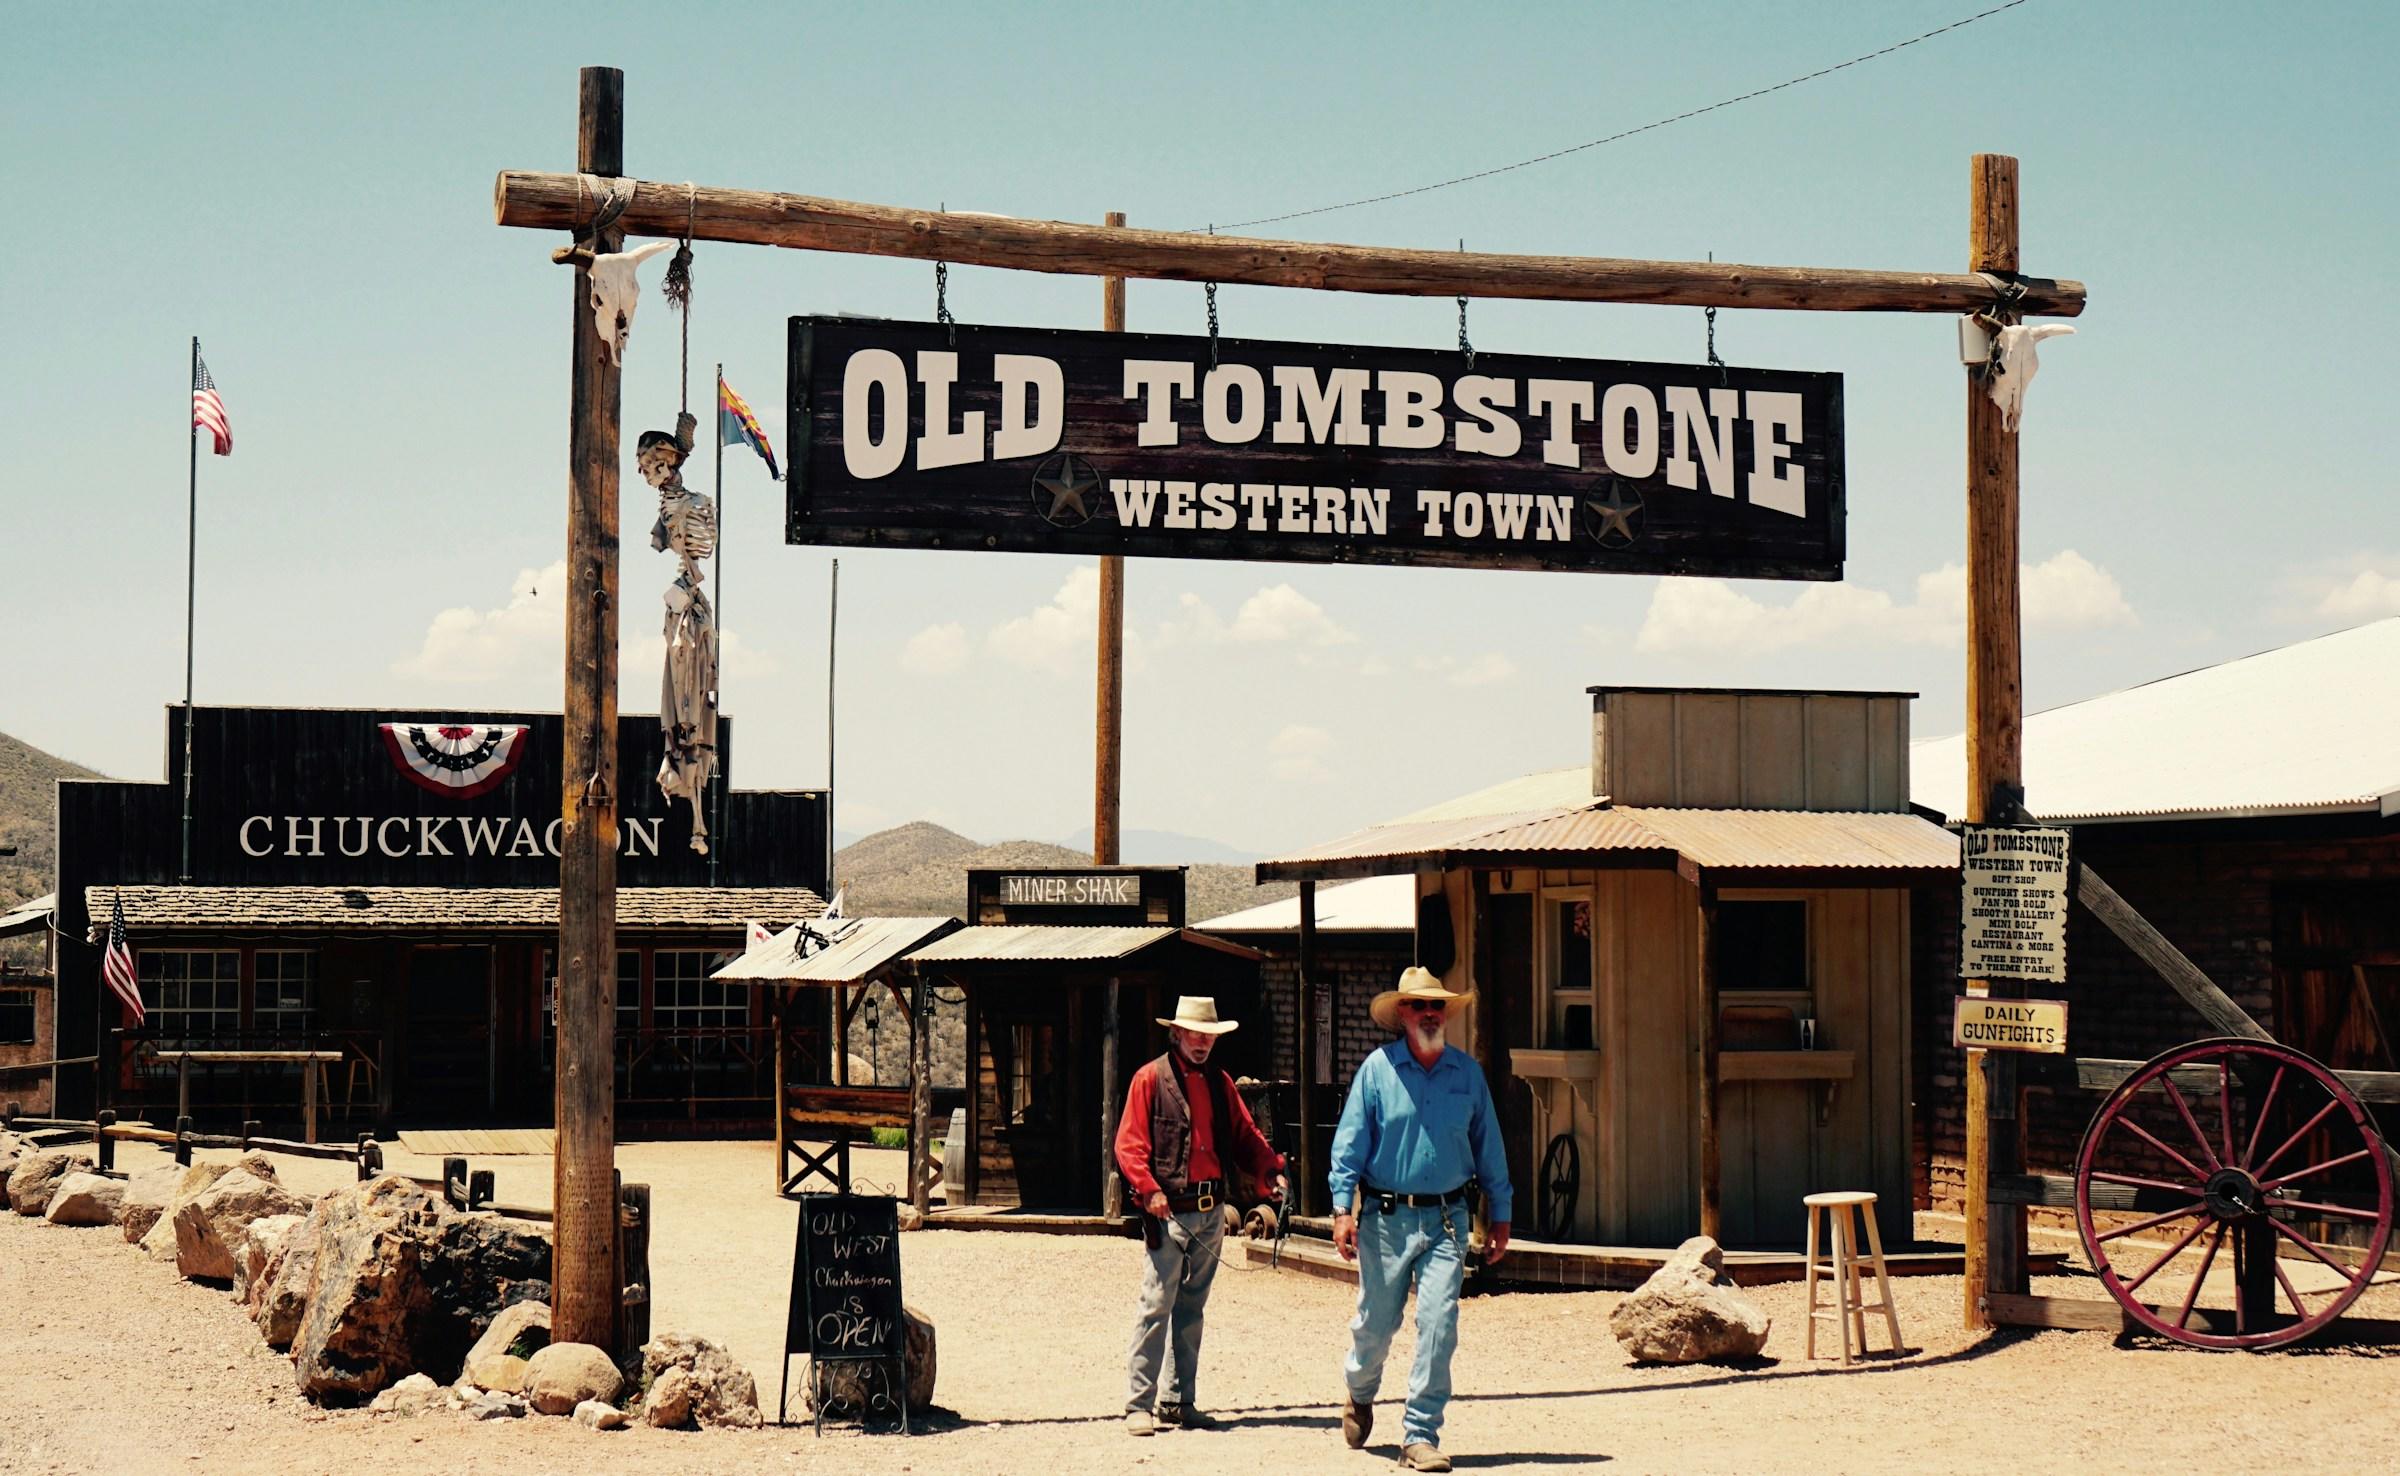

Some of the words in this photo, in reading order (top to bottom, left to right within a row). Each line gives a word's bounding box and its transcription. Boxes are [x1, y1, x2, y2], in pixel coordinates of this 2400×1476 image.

[842, 348, 1064, 480] OLD
[1123, 359, 1806, 518] TOMBSTONE
[1109, 478, 1391, 536] WESTERN
[1417, 489, 1574, 542] TOWN
[239, 815, 664, 857] CHUCKWAN
[1967, 833, 1988, 857] OLD
[1993, 834, 2064, 860] TOMBSTONE
[1968, 857, 2024, 871] WESTERN
[2029, 860, 2062, 873] TOWN
[1992, 875, 2012, 884] GIFT
[2014, 876, 2037, 885] SHOP
[1008, 878, 1067, 903] MINER
[1073, 878, 1129, 903] SHAK
[1973, 887, 2019, 898] GUNFIGHT
[2022, 889, 2055, 899] SHOWS
[1972, 908, 2010, 918] SHOOT'N
[2013, 910, 2055, 920] GALLERY
[1989, 919, 2012, 929] MINI
[2014, 920, 2037, 930] GOLF
[1982, 929, 2044, 941] RESTAURANT
[1971, 939, 2013, 950] CANTINA
[2016, 942, 2024, 951] &
[2028, 942, 2054, 952] MORE
[1980, 954, 2007, 963] FREE
[2010, 955, 2044, 965] ENTRY
[1969, 962, 1983, 971] TO
[1986, 963, 2021, 973] THEME
[2024, 964, 2055, 974] PARK!
[1985, 1006, 2036, 1022] DAILY
[1963, 1022, 2055, 1044] GUNFIGHTS
[812, 1210, 856, 1236] OLD
[833, 1235, 890, 1260] WEST
[816, 1312, 892, 1351] OPEN
